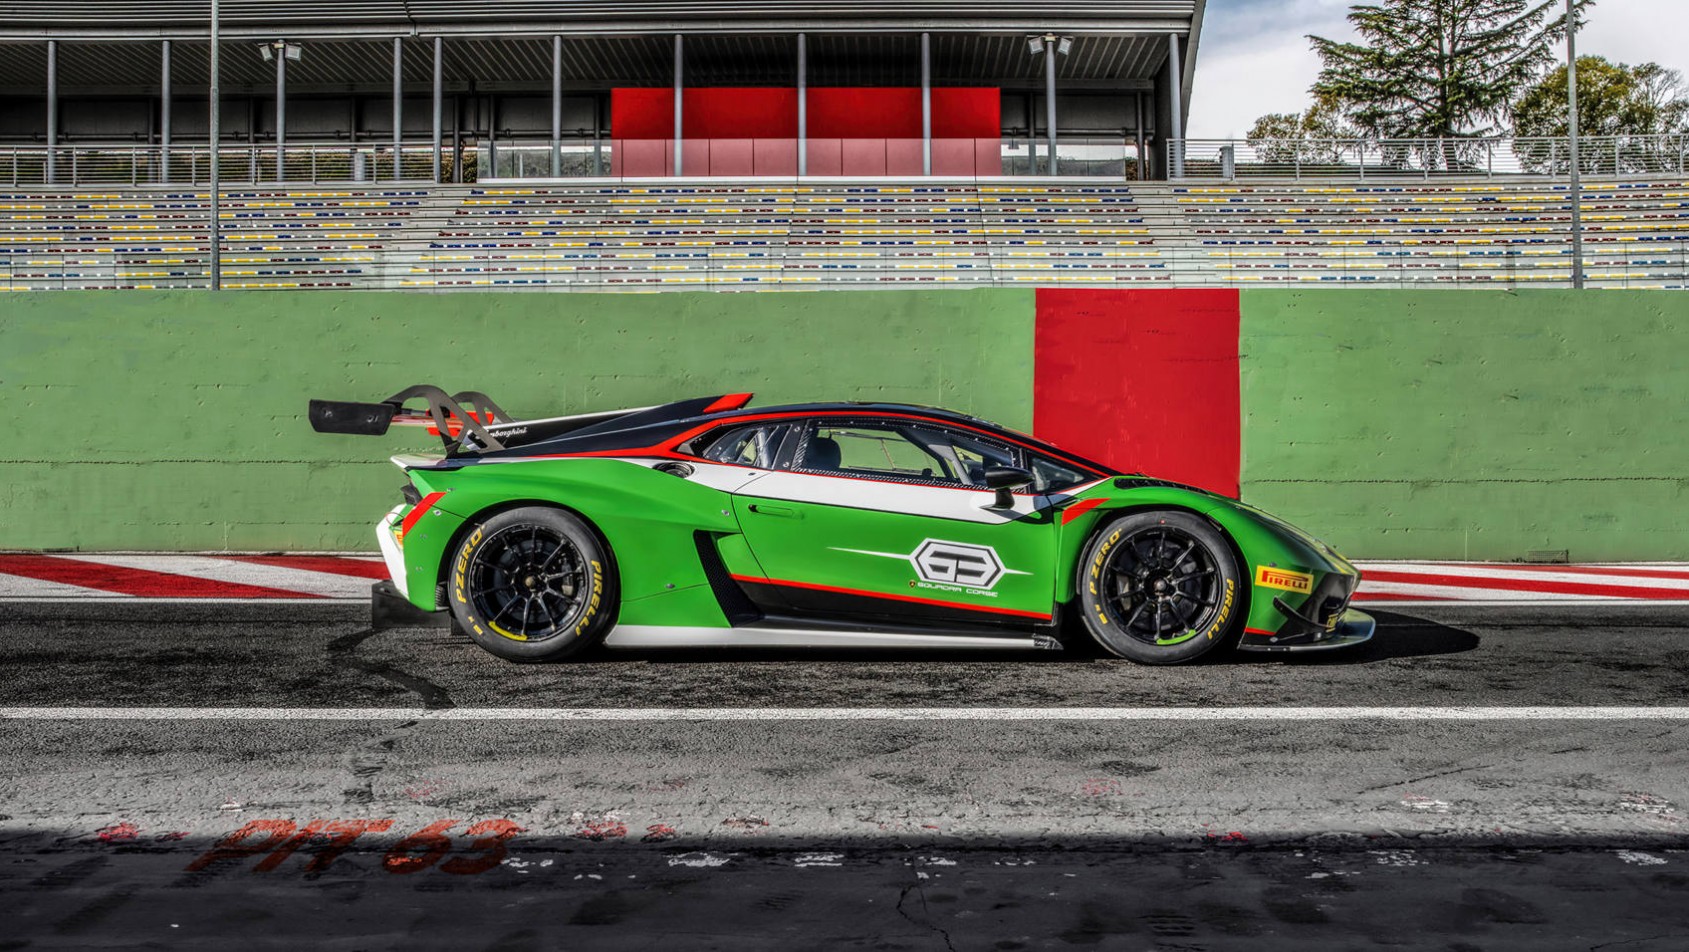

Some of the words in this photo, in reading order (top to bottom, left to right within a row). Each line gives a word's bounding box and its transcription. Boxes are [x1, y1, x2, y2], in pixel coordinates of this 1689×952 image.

[575, 560, 603, 636] PIRELLI
[917, 582, 962, 592] SQUADRA
[966, 588, 998, 597] CORSE
[1261, 570, 1309, 589] PIRELLI
[1207, 579, 1235, 639] PIRELLI
[184, 820, 395, 872] PIT
[383, 820, 525, 875] 63
